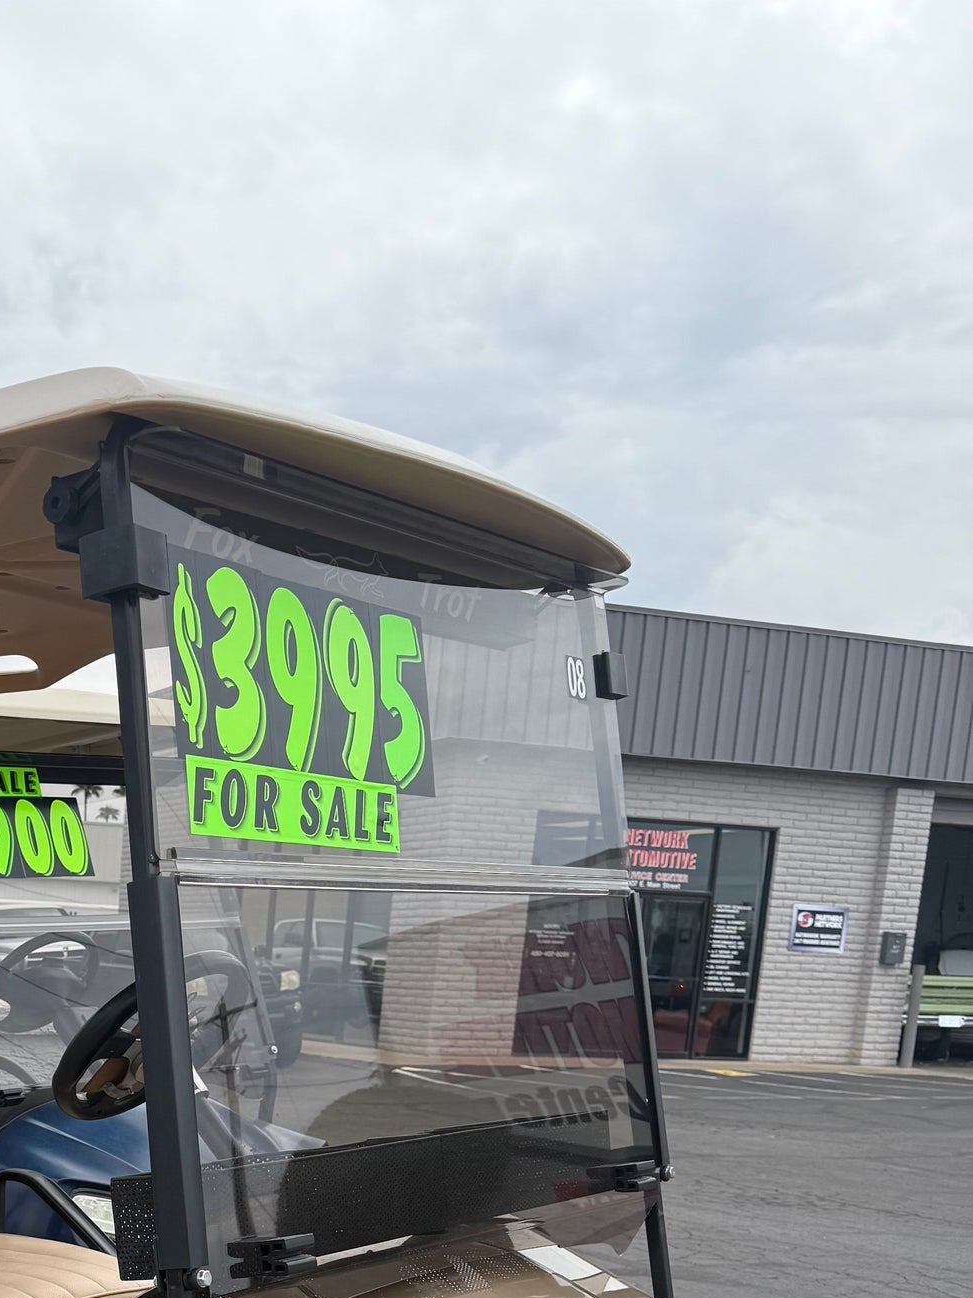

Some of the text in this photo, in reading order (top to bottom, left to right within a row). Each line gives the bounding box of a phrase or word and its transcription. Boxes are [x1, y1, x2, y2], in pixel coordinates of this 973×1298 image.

[183, 507, 260, 564] Fox
[173, 562, 425, 789] $3995
[566, 657, 587, 699] 08
[192, 767, 394, 843] FOR SALE
[625, 848, 698, 870] TOMOTIVE
